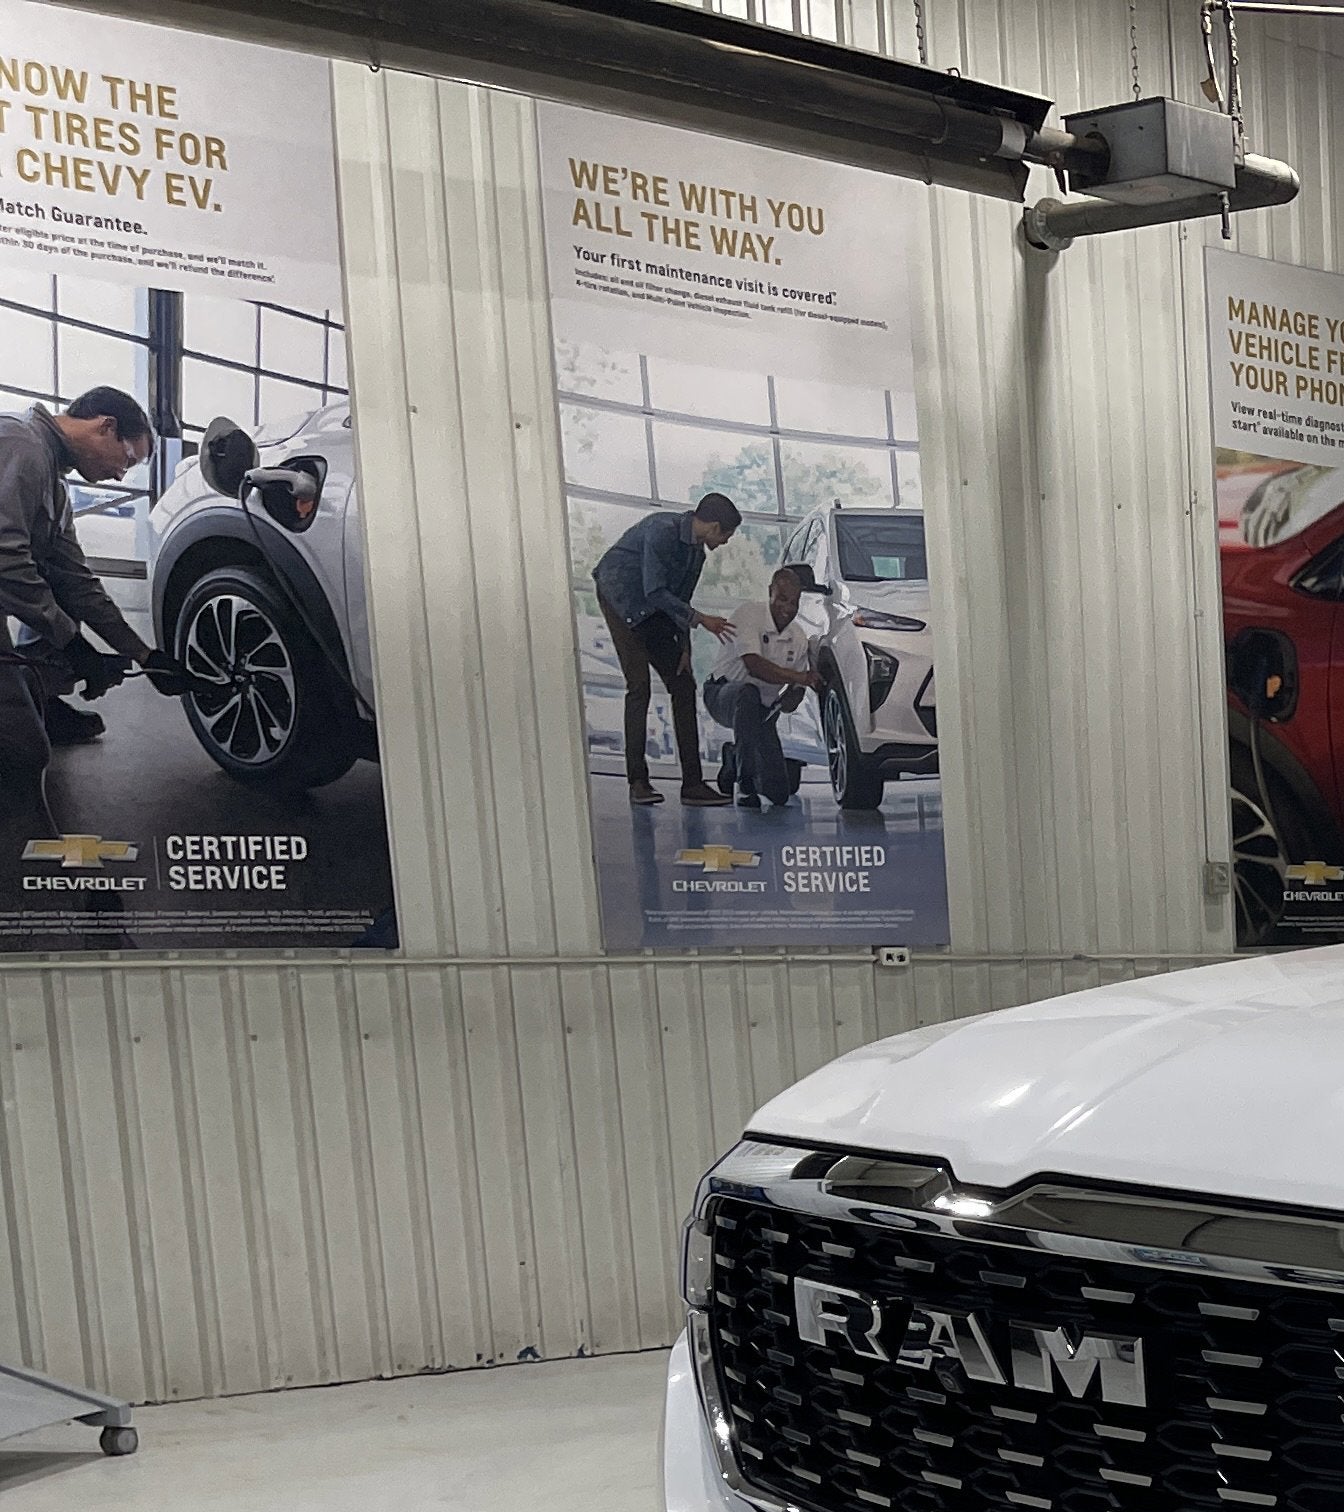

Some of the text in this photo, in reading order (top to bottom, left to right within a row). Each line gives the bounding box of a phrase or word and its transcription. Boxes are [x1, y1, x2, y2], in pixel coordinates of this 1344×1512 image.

[0, 56, 178, 120] NOW THE
[25, 105, 141, 156] TIRES
[155, 128, 228, 171] FOR
[16, 149, 222, 212] CHEVY EV.
[568, 157, 825, 235] WE'RE WITH YOU
[52, 205, 148, 236] Guarantee.
[572, 198, 782, 265] ALL THE WAY.
[573, 245, 607, 263] Your
[610, 253, 642, 271] first
[646, 263, 732, 288] maintenance
[735, 277, 765, 294] visit
[768, 281, 778, 296] is
[1228, 296, 1320, 340] MANAGE
[1228, 328, 1320, 372] VEHICLE
[1230, 361, 1289, 397] YOUR
[1231, 401, 1255, 416] View
[1257, 408, 1303, 426] real-time
[1262, 425, 1304, 442] available
[1306, 433, 1319, 445] on
[1320, 434, 1336, 447] the
[166, 834, 308, 861] CERTIFIED
[781, 845, 886, 868] CERTIFIED
[22, 876, 147, 892] CHEVROLET
[168, 865, 287, 891] SERVICE
[672, 880, 767, 893] CHEVROLET
[783, 871, 871, 893] SERVICE
[793, 1275, 1147, 1408] RAM
